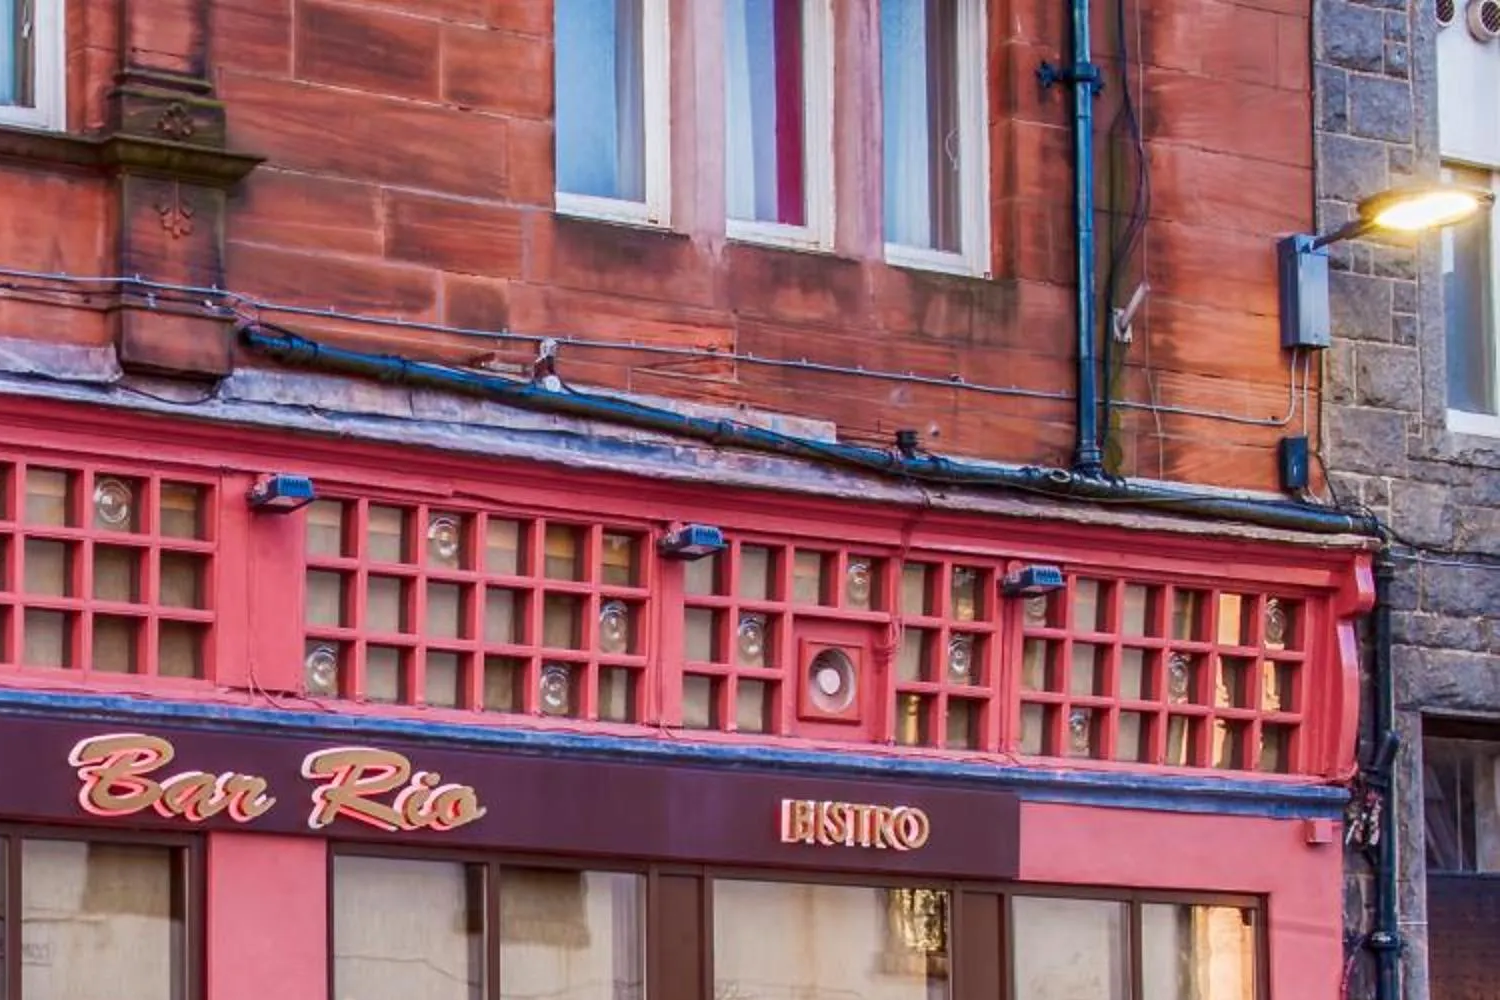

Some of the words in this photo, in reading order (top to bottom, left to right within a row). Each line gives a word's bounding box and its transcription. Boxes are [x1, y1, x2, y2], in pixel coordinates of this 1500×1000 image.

[69, 733, 276, 823] Bar
[301, 747, 486, 832] Rio
[781, 798, 930, 850] BISTRO
